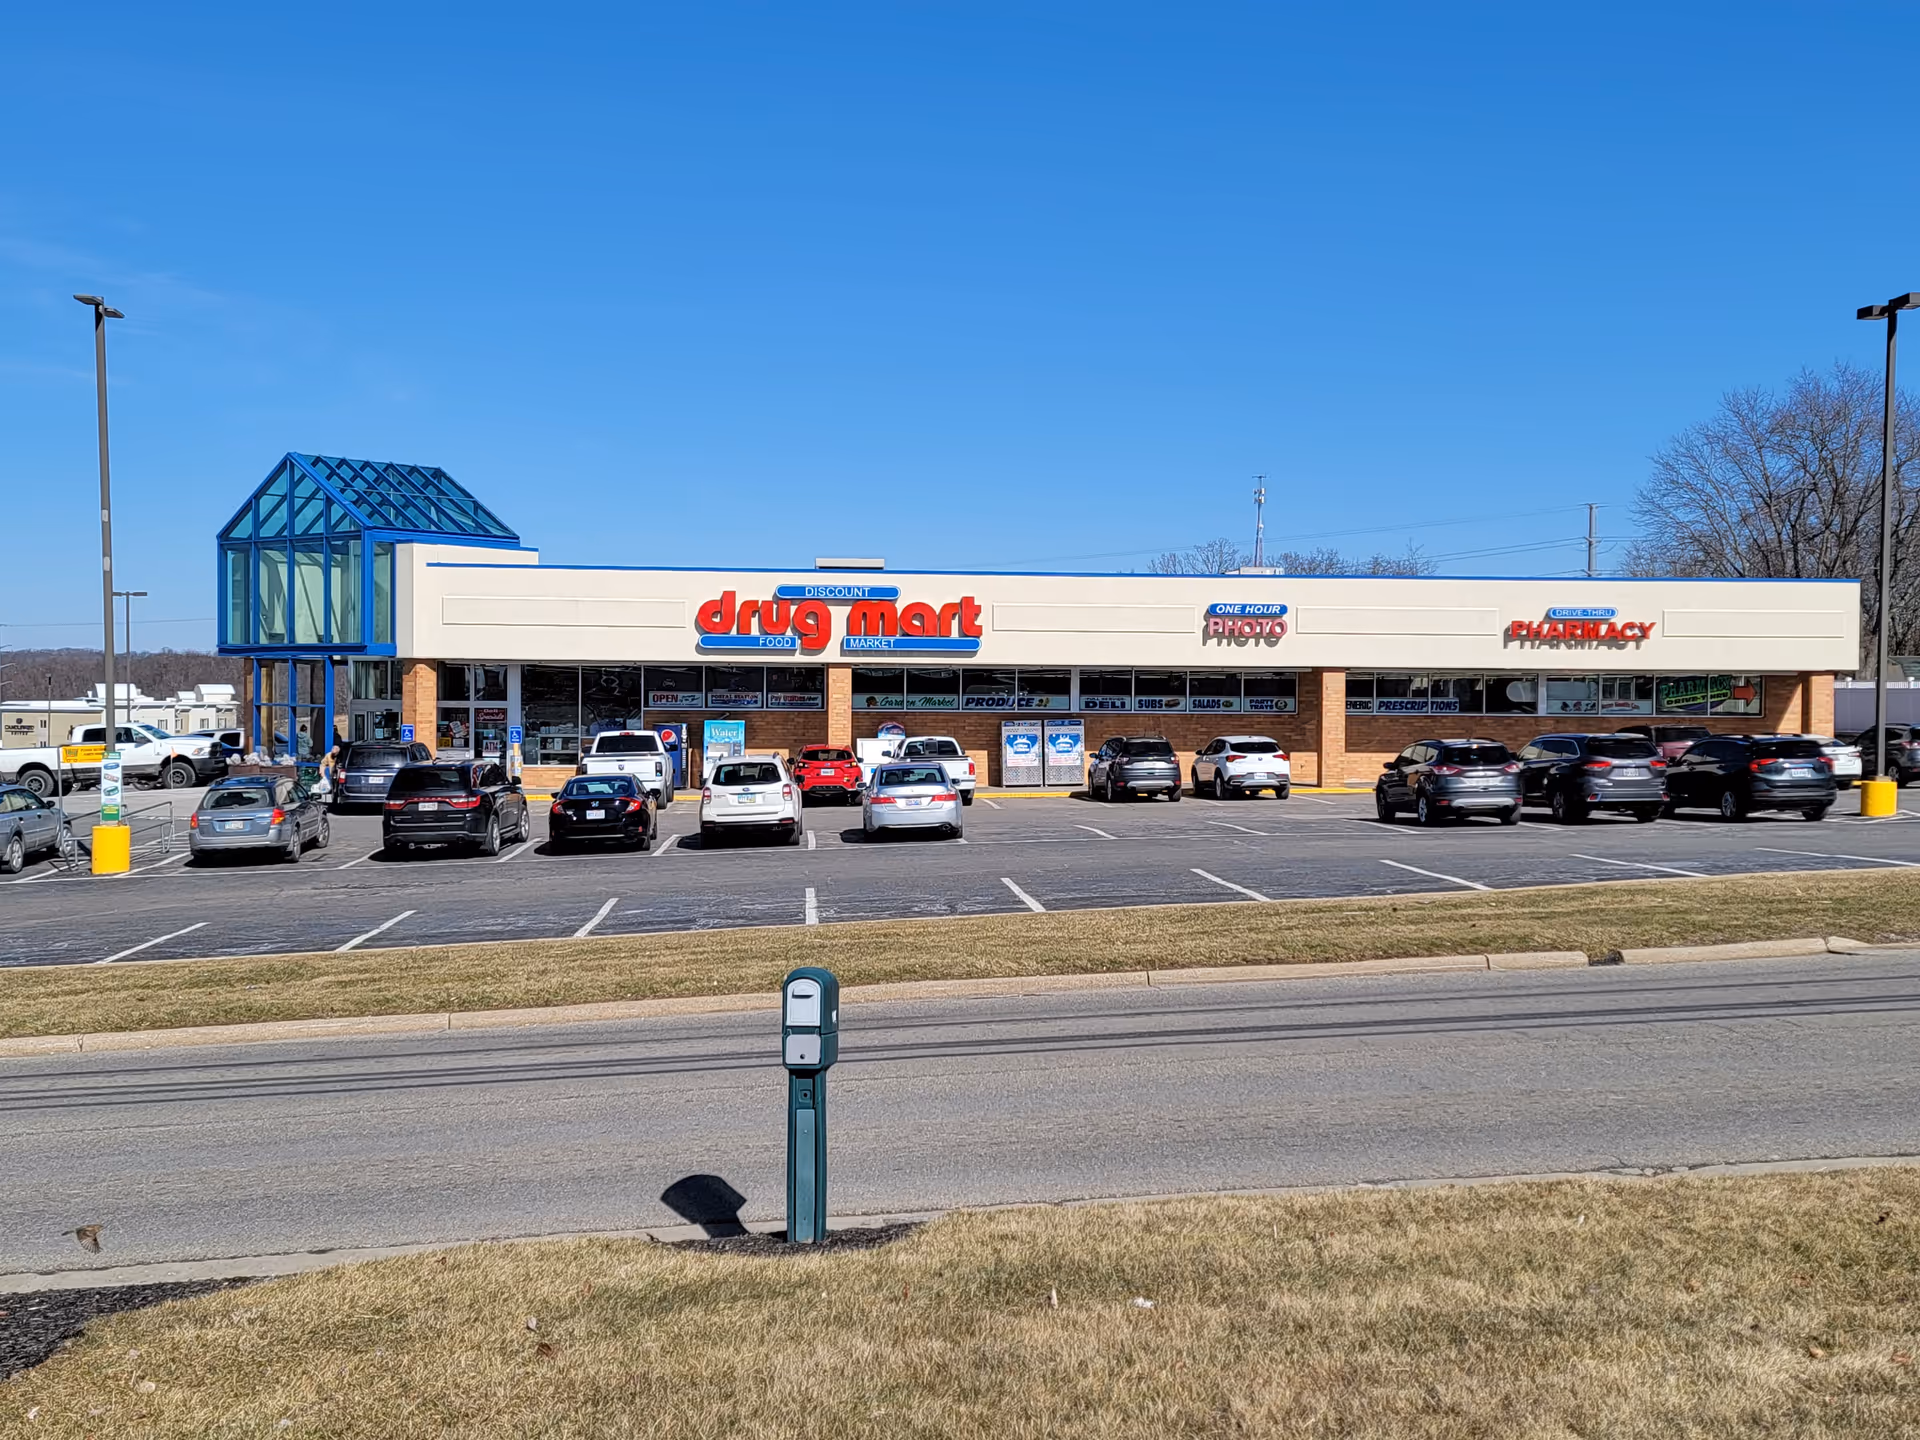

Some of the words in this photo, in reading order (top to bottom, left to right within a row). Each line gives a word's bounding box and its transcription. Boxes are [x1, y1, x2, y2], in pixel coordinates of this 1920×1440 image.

[805, 587, 871, 597] DISCOUNT
[1216, 605, 1242, 613] ONE
[1245, 605, 1281, 614] HOUR
[1556, 609, 1612, 617] DRIVE-THRU
[697, 590, 832, 650] drug
[849, 596, 983, 637] mart
[1209, 617, 1288, 637] PHOTO
[1511, 620, 1657, 640] PHARMACY
[759, 638, 791, 647] FOOD
[850, 639, 896, 648] MARKET
[1660, 675, 1733, 698] PHARMACY
[652, 694, 678, 703] OPEN
[879, 696, 917, 707] Garden
[917, 696, 957, 707] Market
[964, 697, 1035, 708] PRODUCE
[1137, 699, 1164, 708] SUBS
[1192, 699, 1221, 708] SALADS
[1666, 691, 1729, 706] DRIVE-THRU
[1084, 701, 1126, 709] DELI
[1346, 701, 1372, 710] ENERIC
[1378, 701, 1458, 711] PRESCRIPTIONS
[711, 727, 737, 737] Water
[484, 741, 498, 752] ATM
